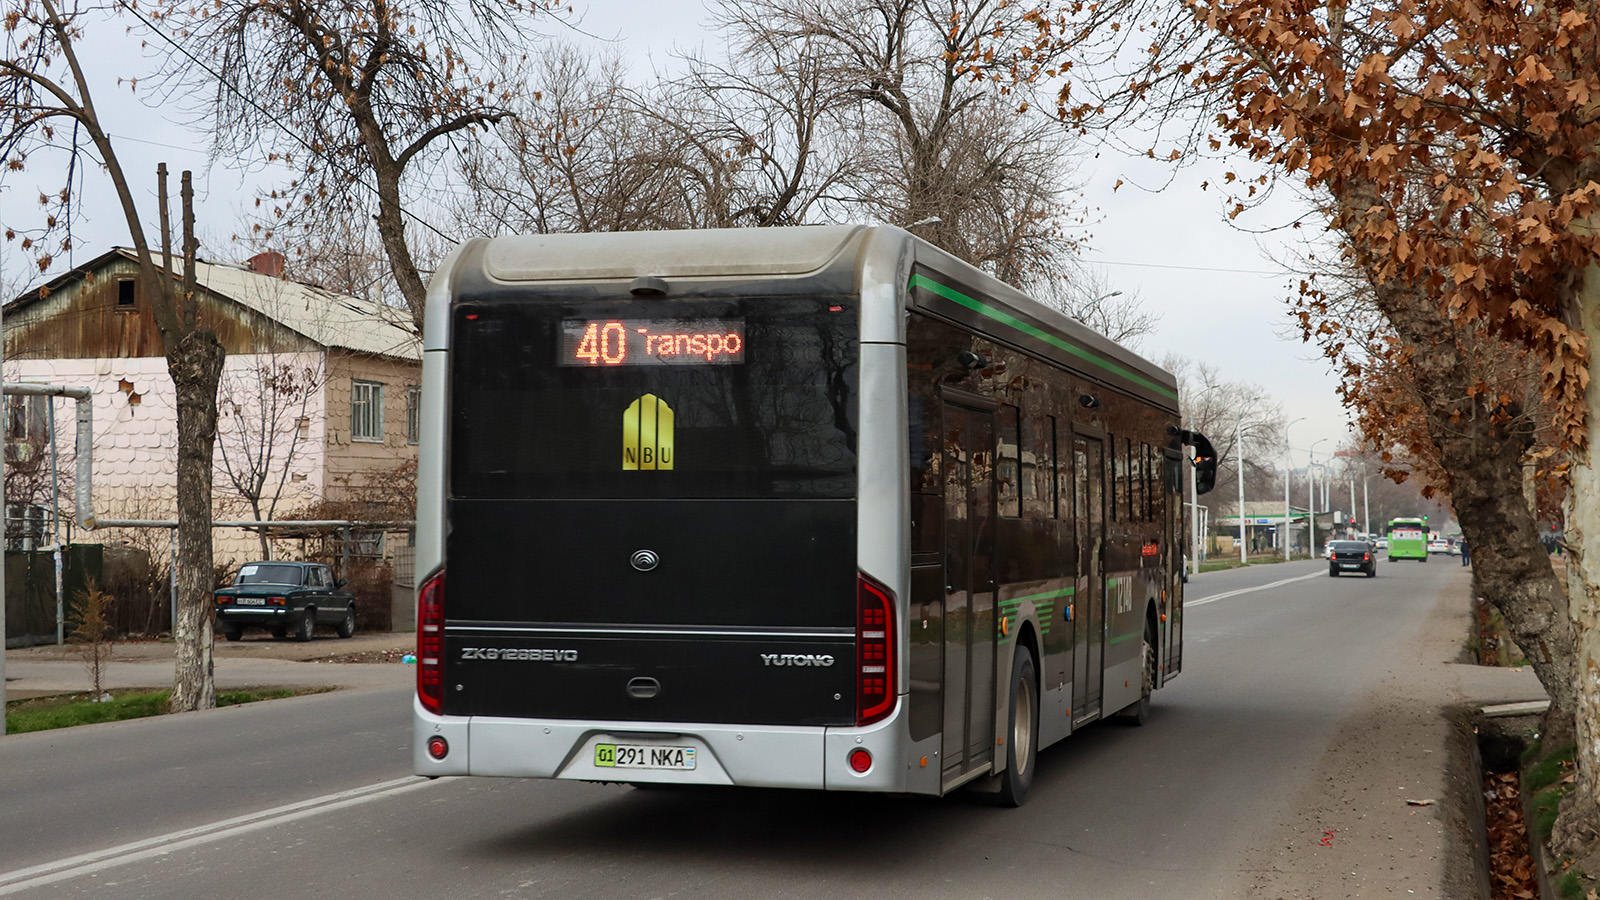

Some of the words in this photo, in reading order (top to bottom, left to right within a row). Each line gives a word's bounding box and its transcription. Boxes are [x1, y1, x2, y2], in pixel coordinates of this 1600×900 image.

[576, 322, 626, 364] 40
[637, 328, 742, 361] ranspo
[625, 447, 671, 464] NBU
[760, 653, 835, 667] YUTONG
[599, 749, 614, 762] 01
[617, 748, 646, 765] 291
[651, 749, 685, 766] NKA
